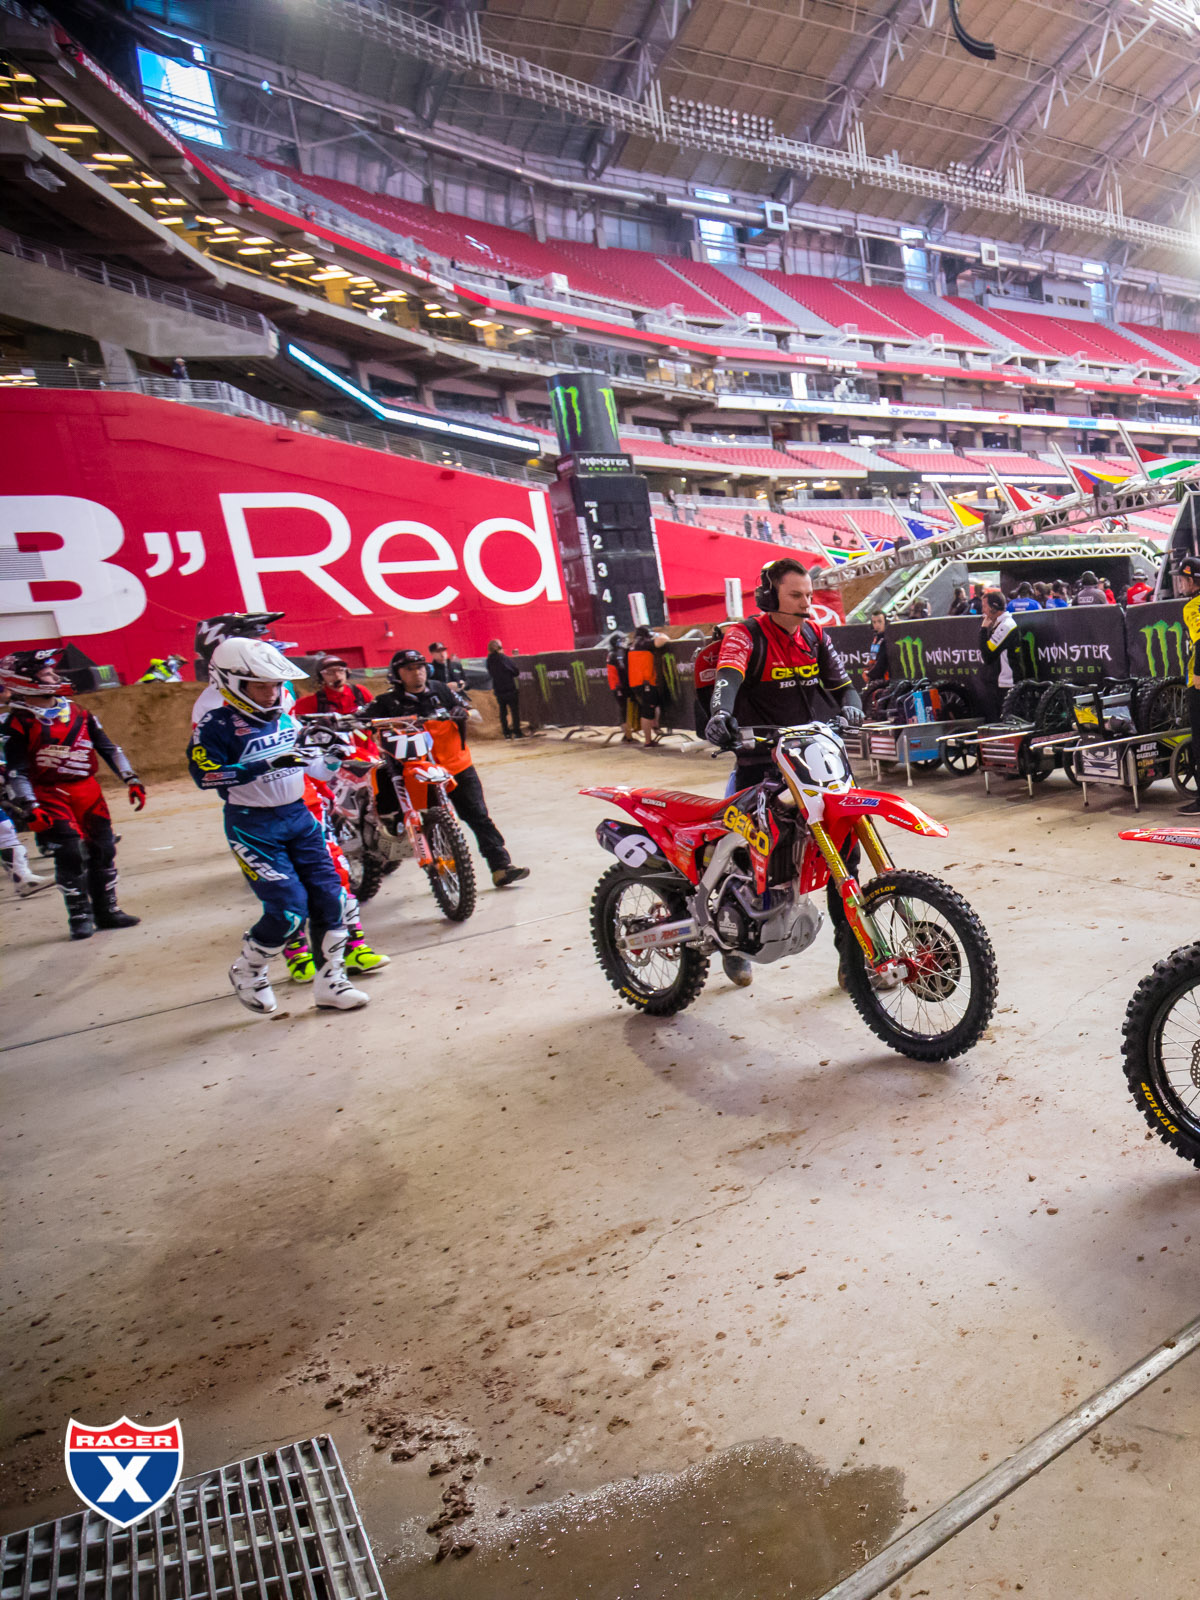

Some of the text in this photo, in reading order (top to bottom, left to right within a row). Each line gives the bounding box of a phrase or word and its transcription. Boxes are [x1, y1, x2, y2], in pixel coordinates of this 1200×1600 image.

[589, 509, 598, 523] 1
[592, 535, 603, 549] 2
[219, 490, 563, 615] Red
[597, 563, 608, 577] 3
[602, 589, 612, 603] 4
[606, 616, 617, 631] 5
[925, 647, 985, 666] MONSTER
[1037, 642, 1113, 663] MONSTER
[771, 663, 820, 680] GEICO
[387, 732, 428, 760] 71
[804, 742, 846, 783] 6
[839, 796, 881, 808] AMSOIL
[723, 805, 770, 857] GEICO
[614, 834, 658, 869] 6
[852, 925, 874, 961] GEICO
[1140, 1082, 1180, 1135] DUNLOP
